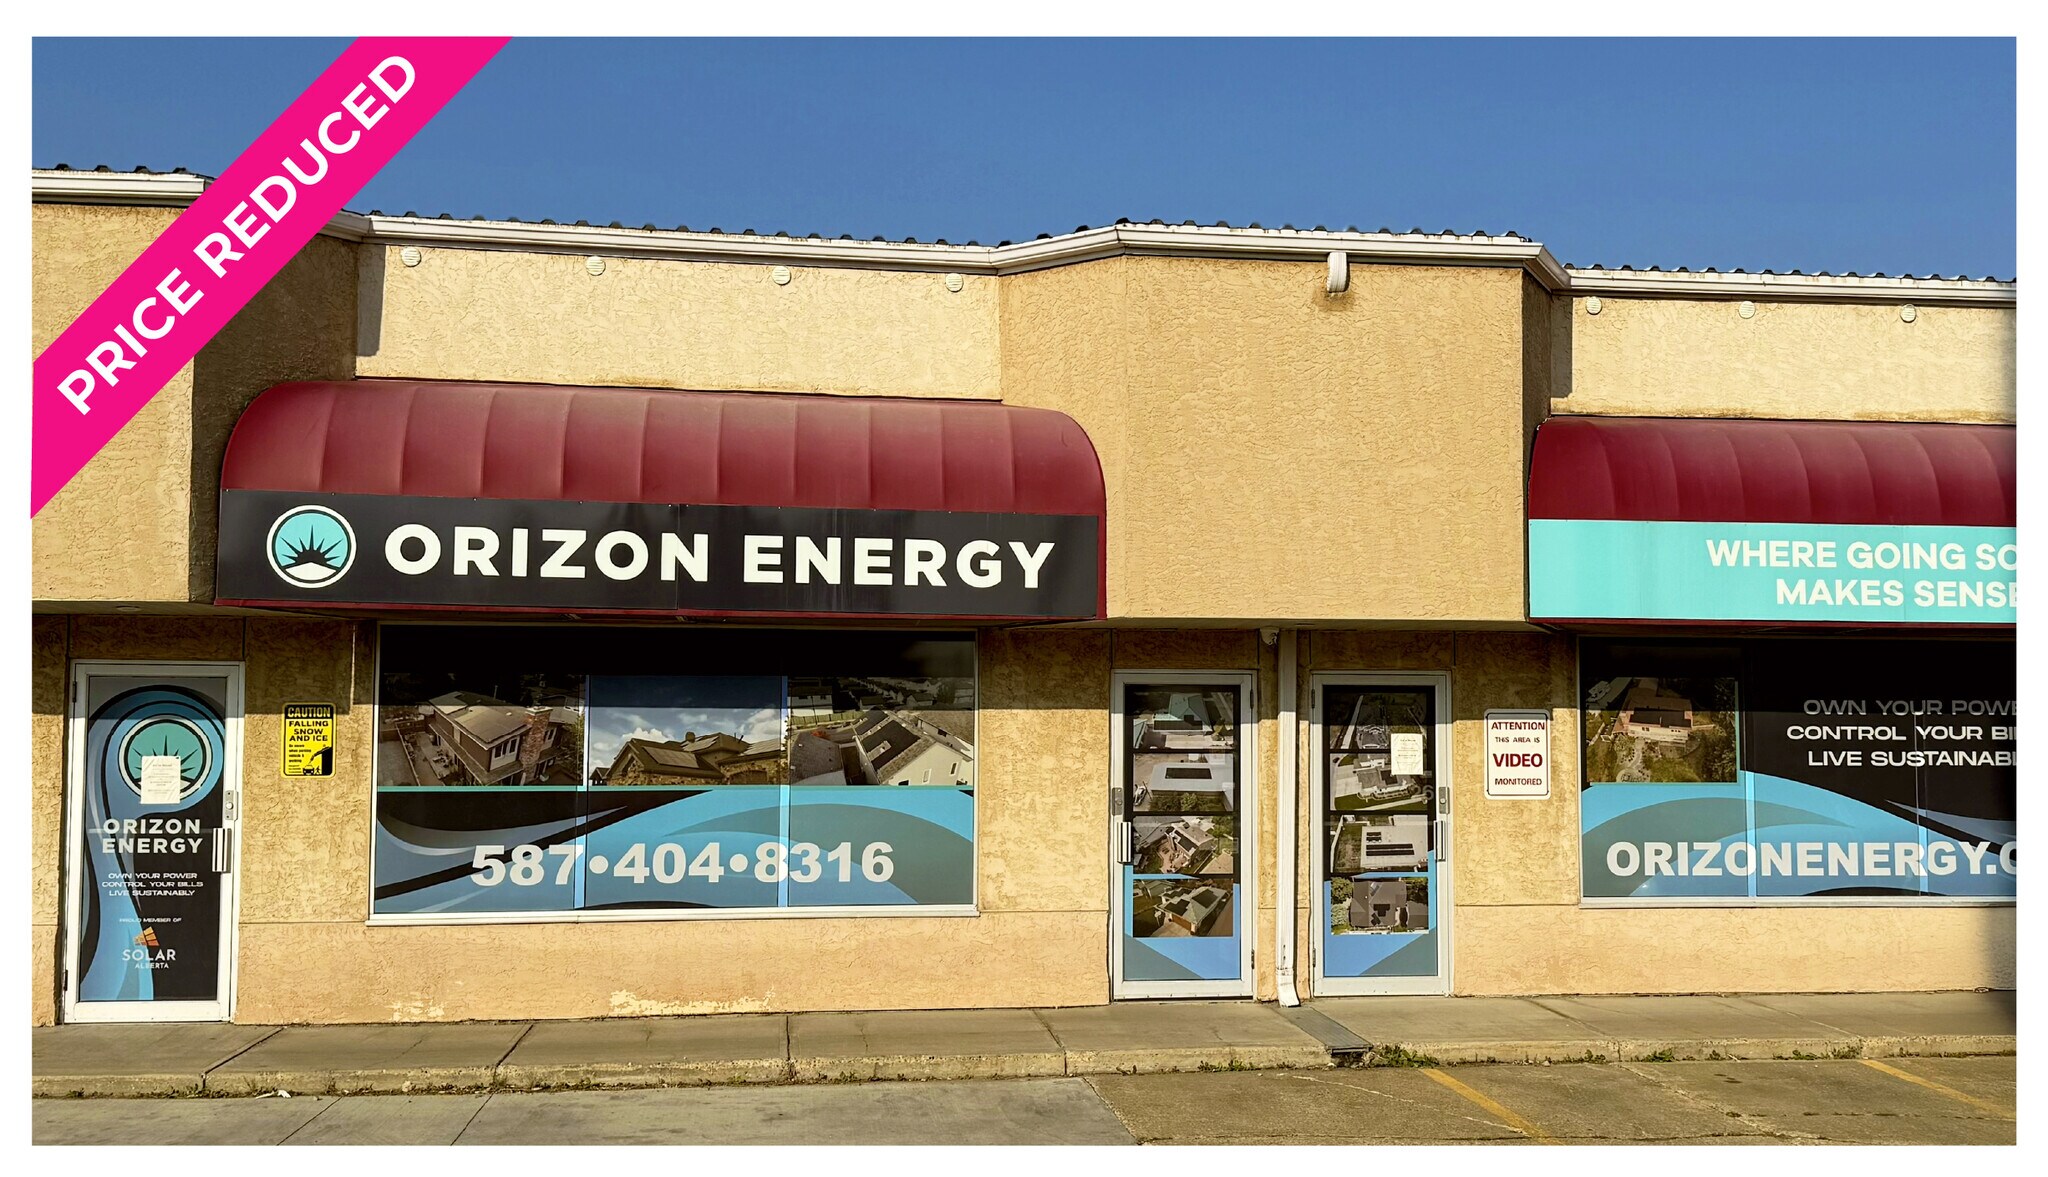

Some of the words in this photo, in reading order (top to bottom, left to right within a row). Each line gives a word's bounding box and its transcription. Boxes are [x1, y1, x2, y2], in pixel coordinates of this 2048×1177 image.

[384, 523, 709, 582] ORIZON
[743, 534, 1055, 589] ENERGY
[1706, 539, 1837, 568] WHERE
[1846, 541, 1966, 570] GOING
[1776, 578, 1904, 606] MAKES
[287, 707, 331, 717] CAUTION
[1803, 700, 1866, 715] OWN
[1876, 700, 1942, 716] YOUR
[1491, 721, 1545, 730] ATTENTION
[1786, 725, 1907, 740] CONTROL
[1915, 726, 1982, 740] YOUR
[1492, 753, 1543, 767] VIDEO
[1808, 751, 1862, 766] LIVE
[1494, 778, 1542, 786] MONITORED
[103, 818, 200, 834] ORIZON
[102, 838, 203, 853] ENERGY
[122, 949, 176, 961] SOLAR
